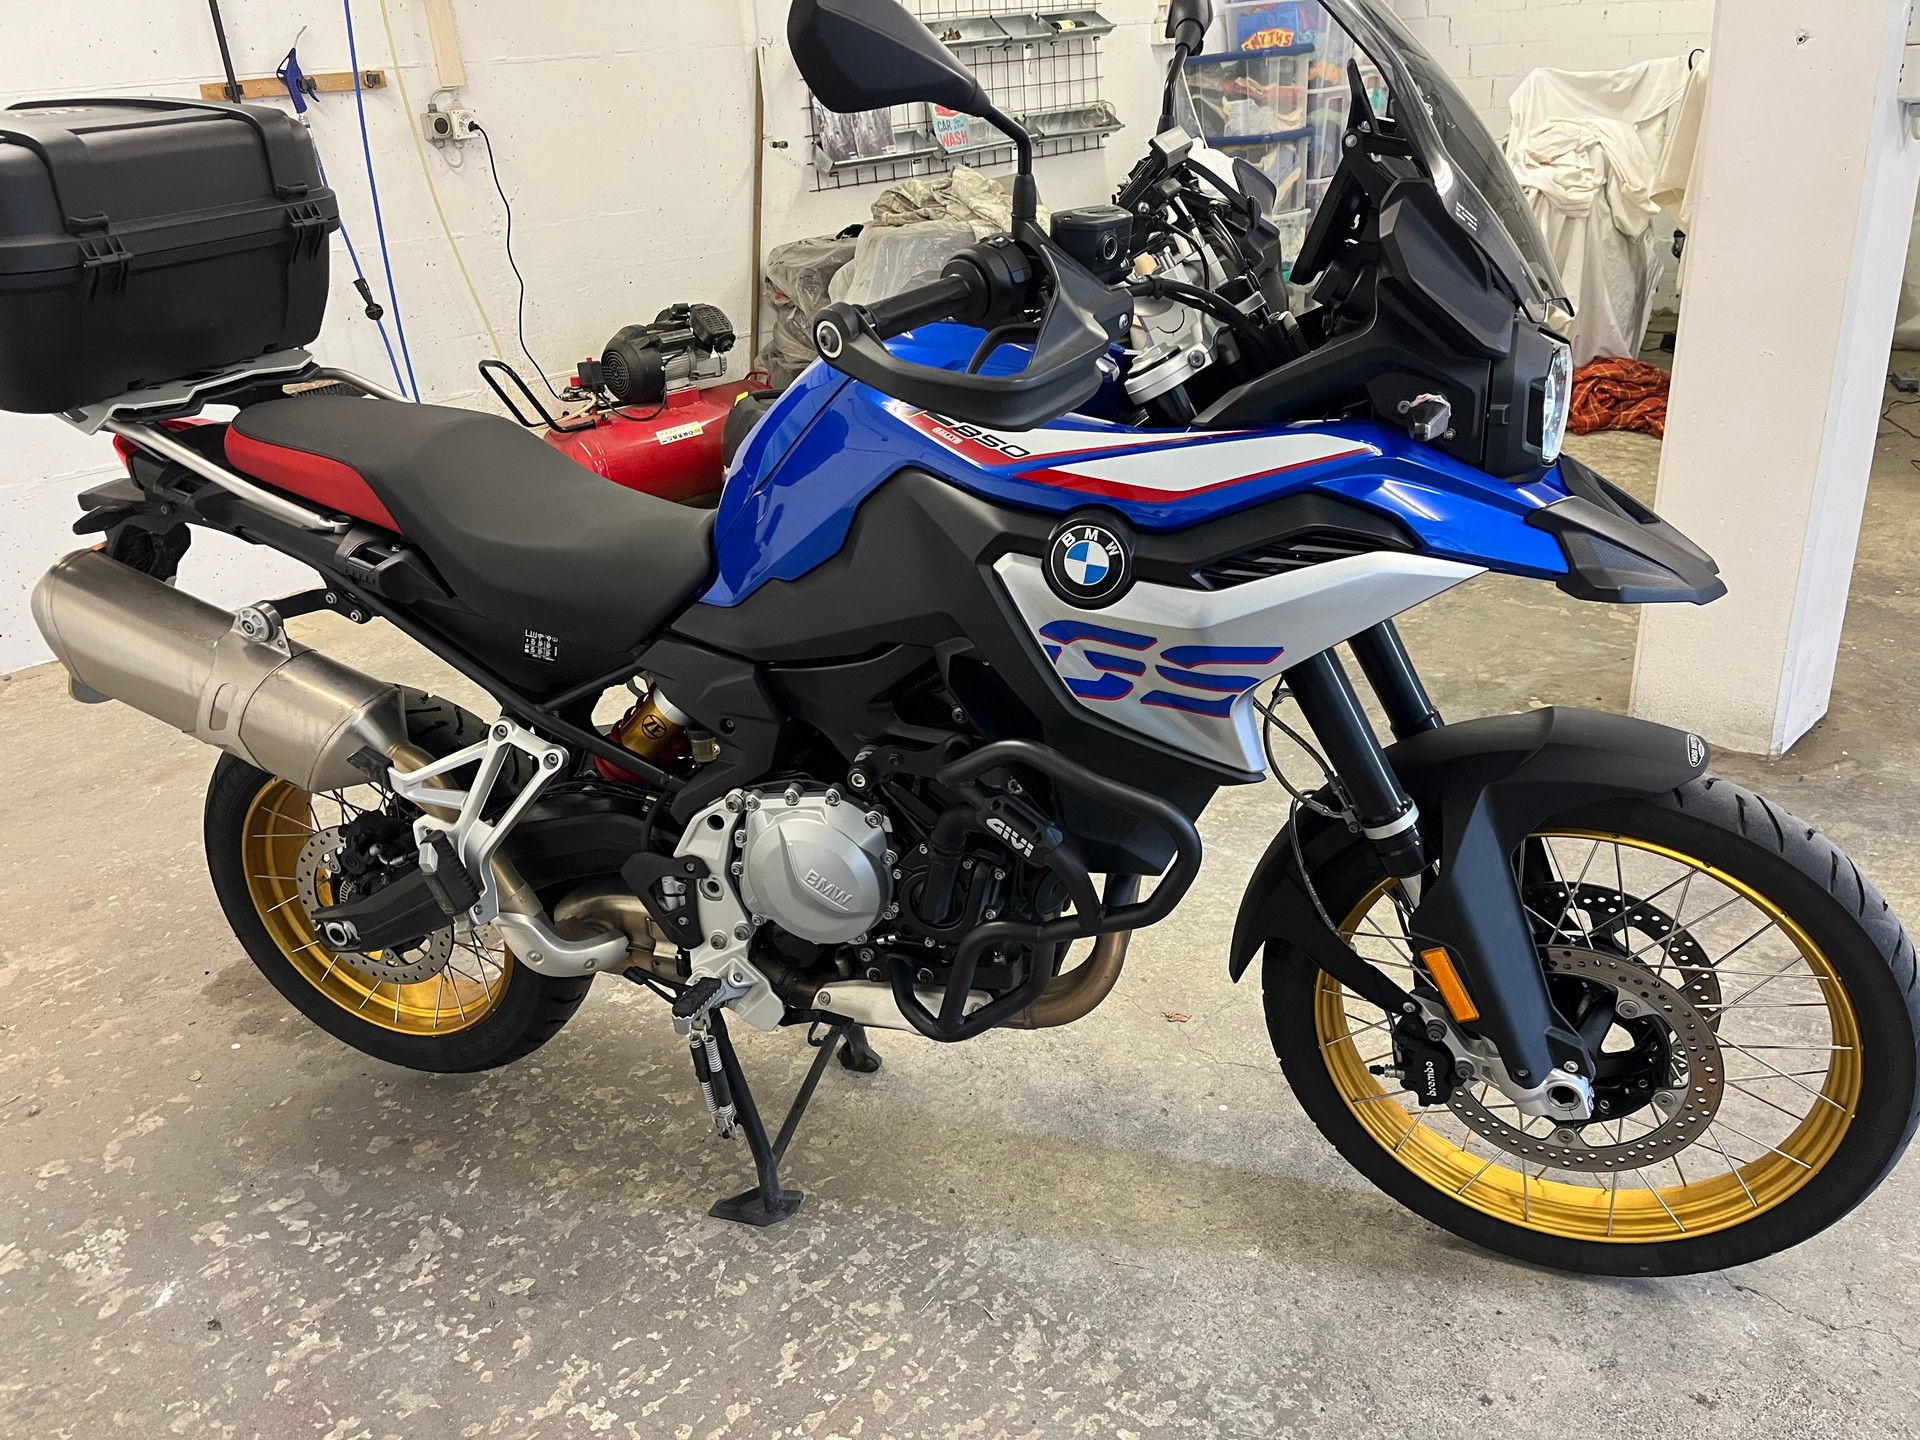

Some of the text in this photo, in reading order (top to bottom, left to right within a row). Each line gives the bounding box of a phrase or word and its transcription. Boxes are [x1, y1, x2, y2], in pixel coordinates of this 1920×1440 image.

[937, 119, 953, 132] CAR
[940, 130, 969, 148] WASH
[1061, 527, 1120, 556] BMW
[1039, 620, 1284, 718] GS
[642, 715, 667, 739] ZF
[986, 818, 1034, 855] GIVI
[804, 868, 853, 905] BMW
[1423, 1061, 1437, 1097] brembo
